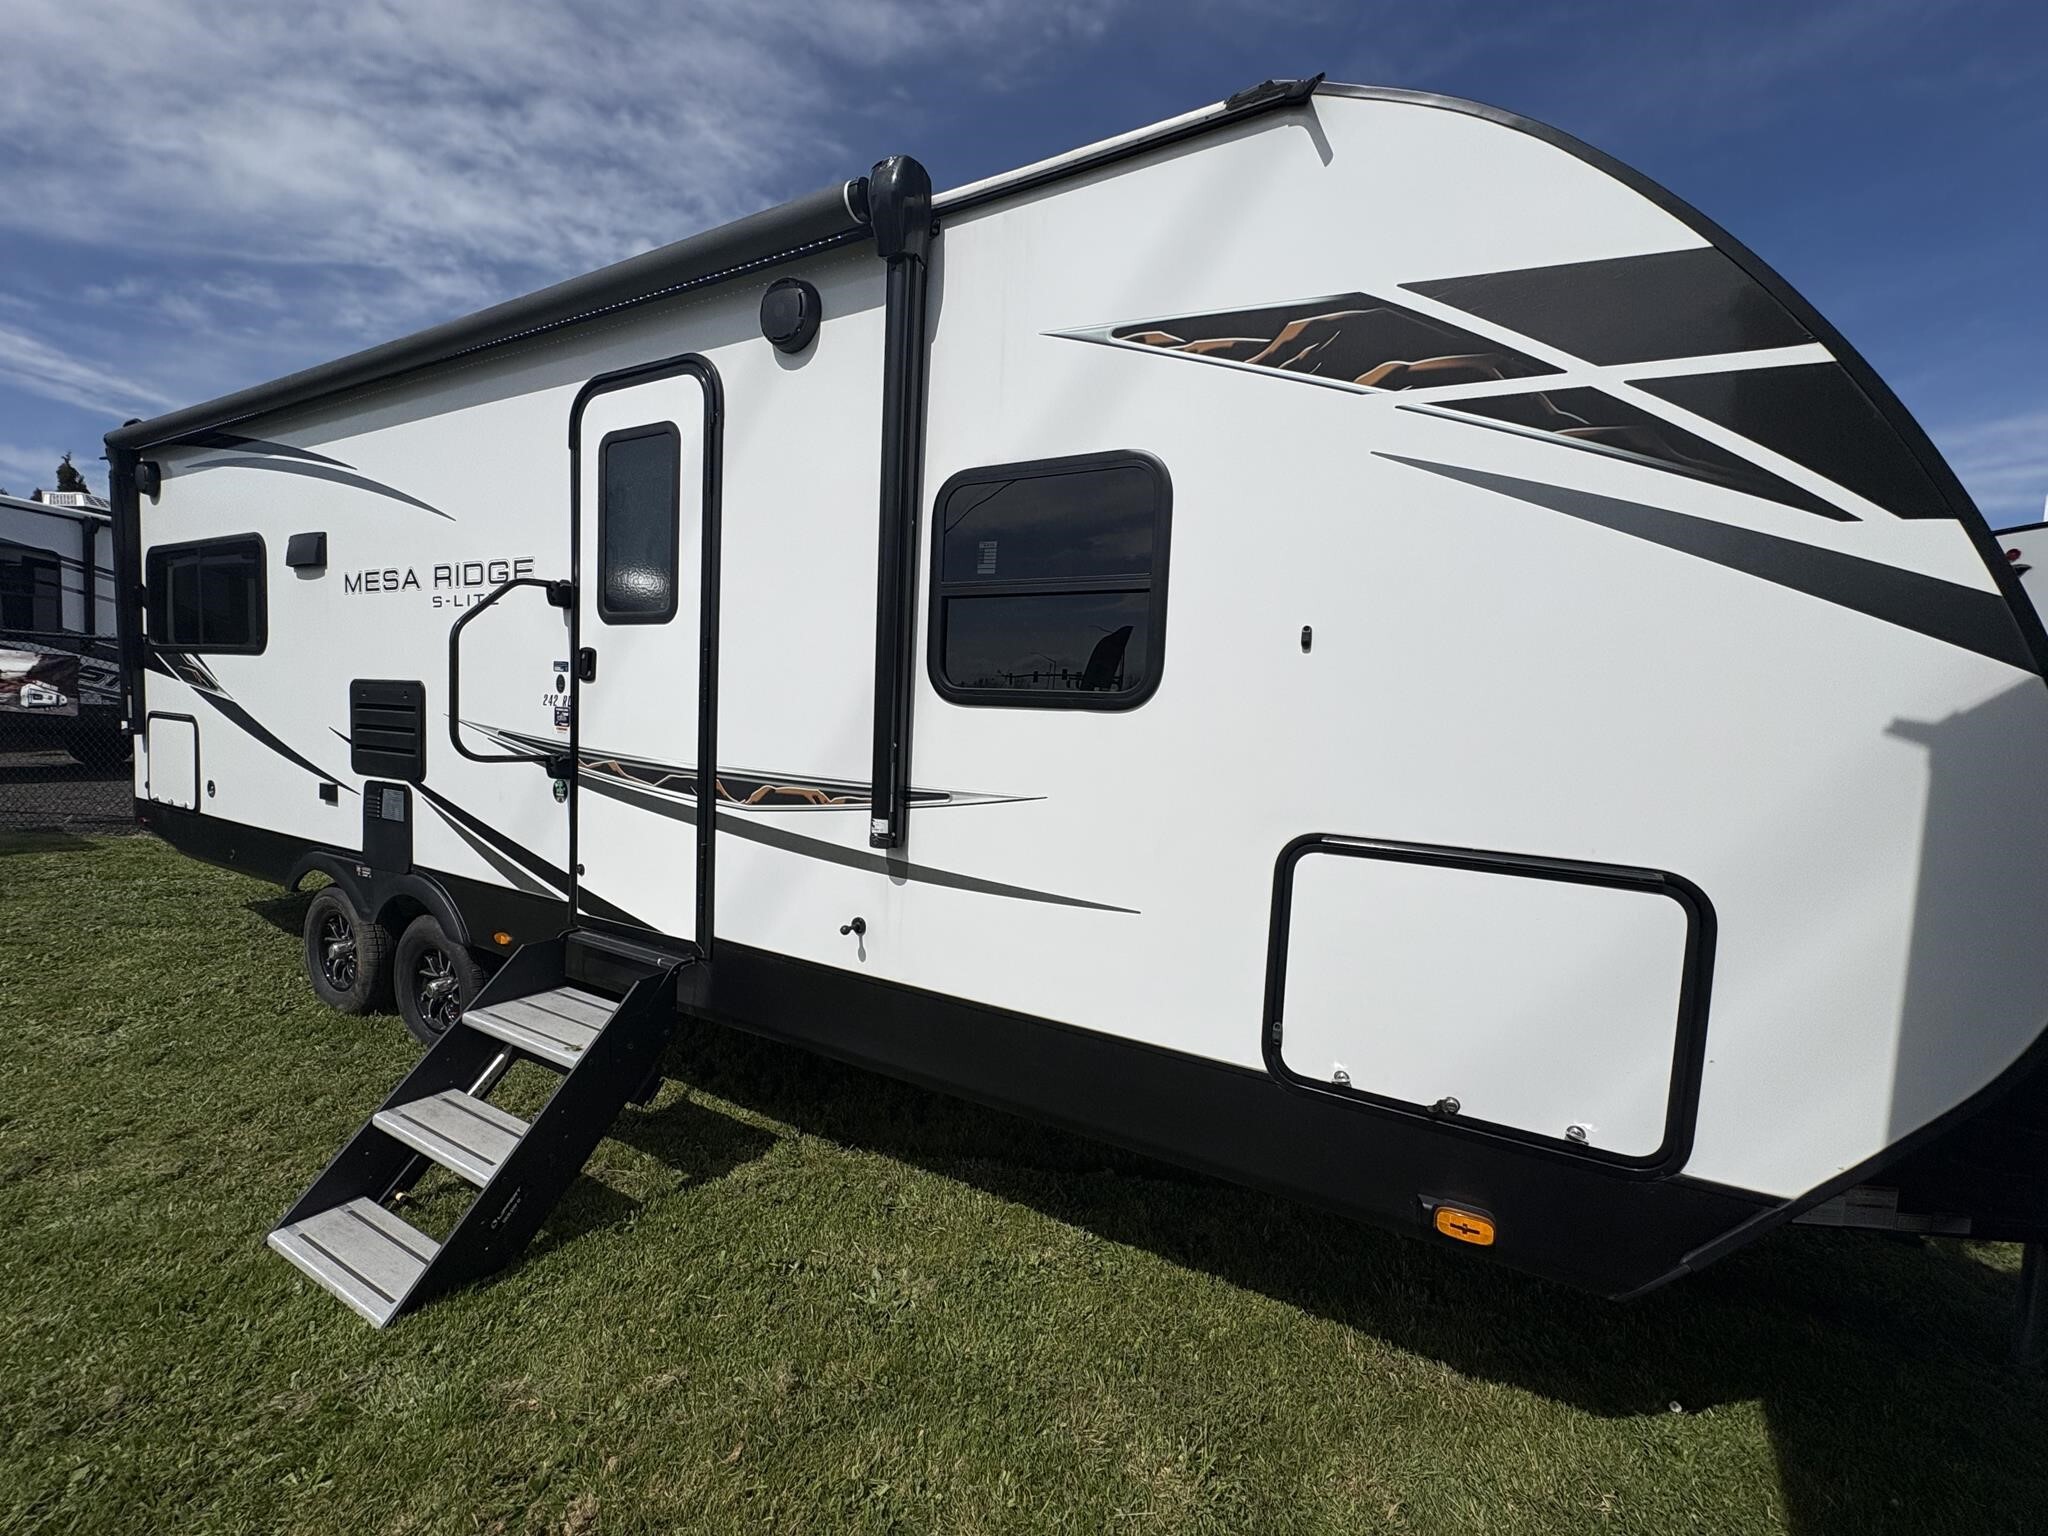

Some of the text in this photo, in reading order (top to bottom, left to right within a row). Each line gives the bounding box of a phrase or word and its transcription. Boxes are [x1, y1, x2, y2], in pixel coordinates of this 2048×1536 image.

[344, 556, 535, 595] MESA RIDGE
[432, 593, 499, 608] S-LIT
[542, 694, 559, 707] 242
